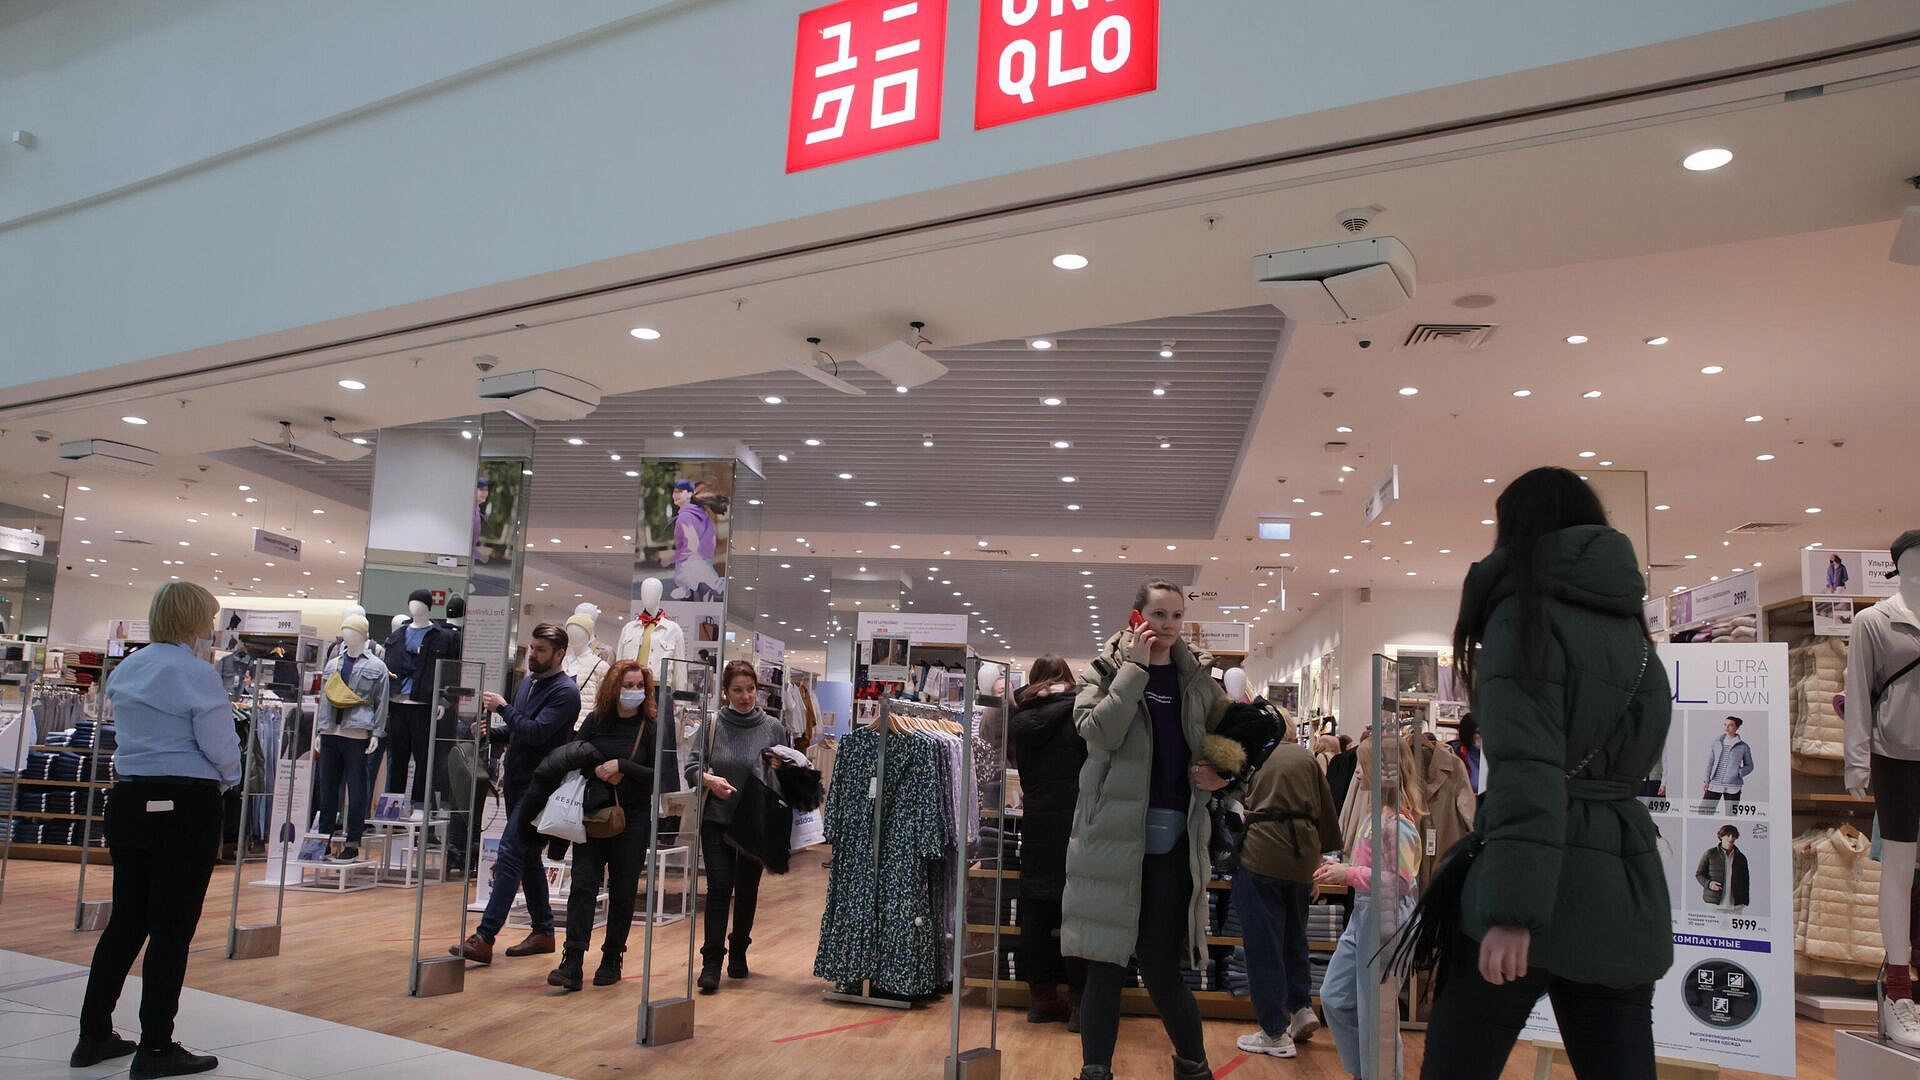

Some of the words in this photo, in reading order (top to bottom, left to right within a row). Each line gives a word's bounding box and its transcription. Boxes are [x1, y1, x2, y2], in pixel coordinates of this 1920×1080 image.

[815, 2, 920, 78] ユニ
[998, 15, 1131, 104] QLO
[805, 68, 918, 145] クロ
[1715, 659, 1769, 673] ULTRA
[1715, 675, 1769, 689] LIGHT
[1715, 691, 1770, 705] DOWN
[1648, 800, 1671, 811] 4999
[1732, 804, 1756, 815] 5999
[1732, 918, 1757, 931] 5999
